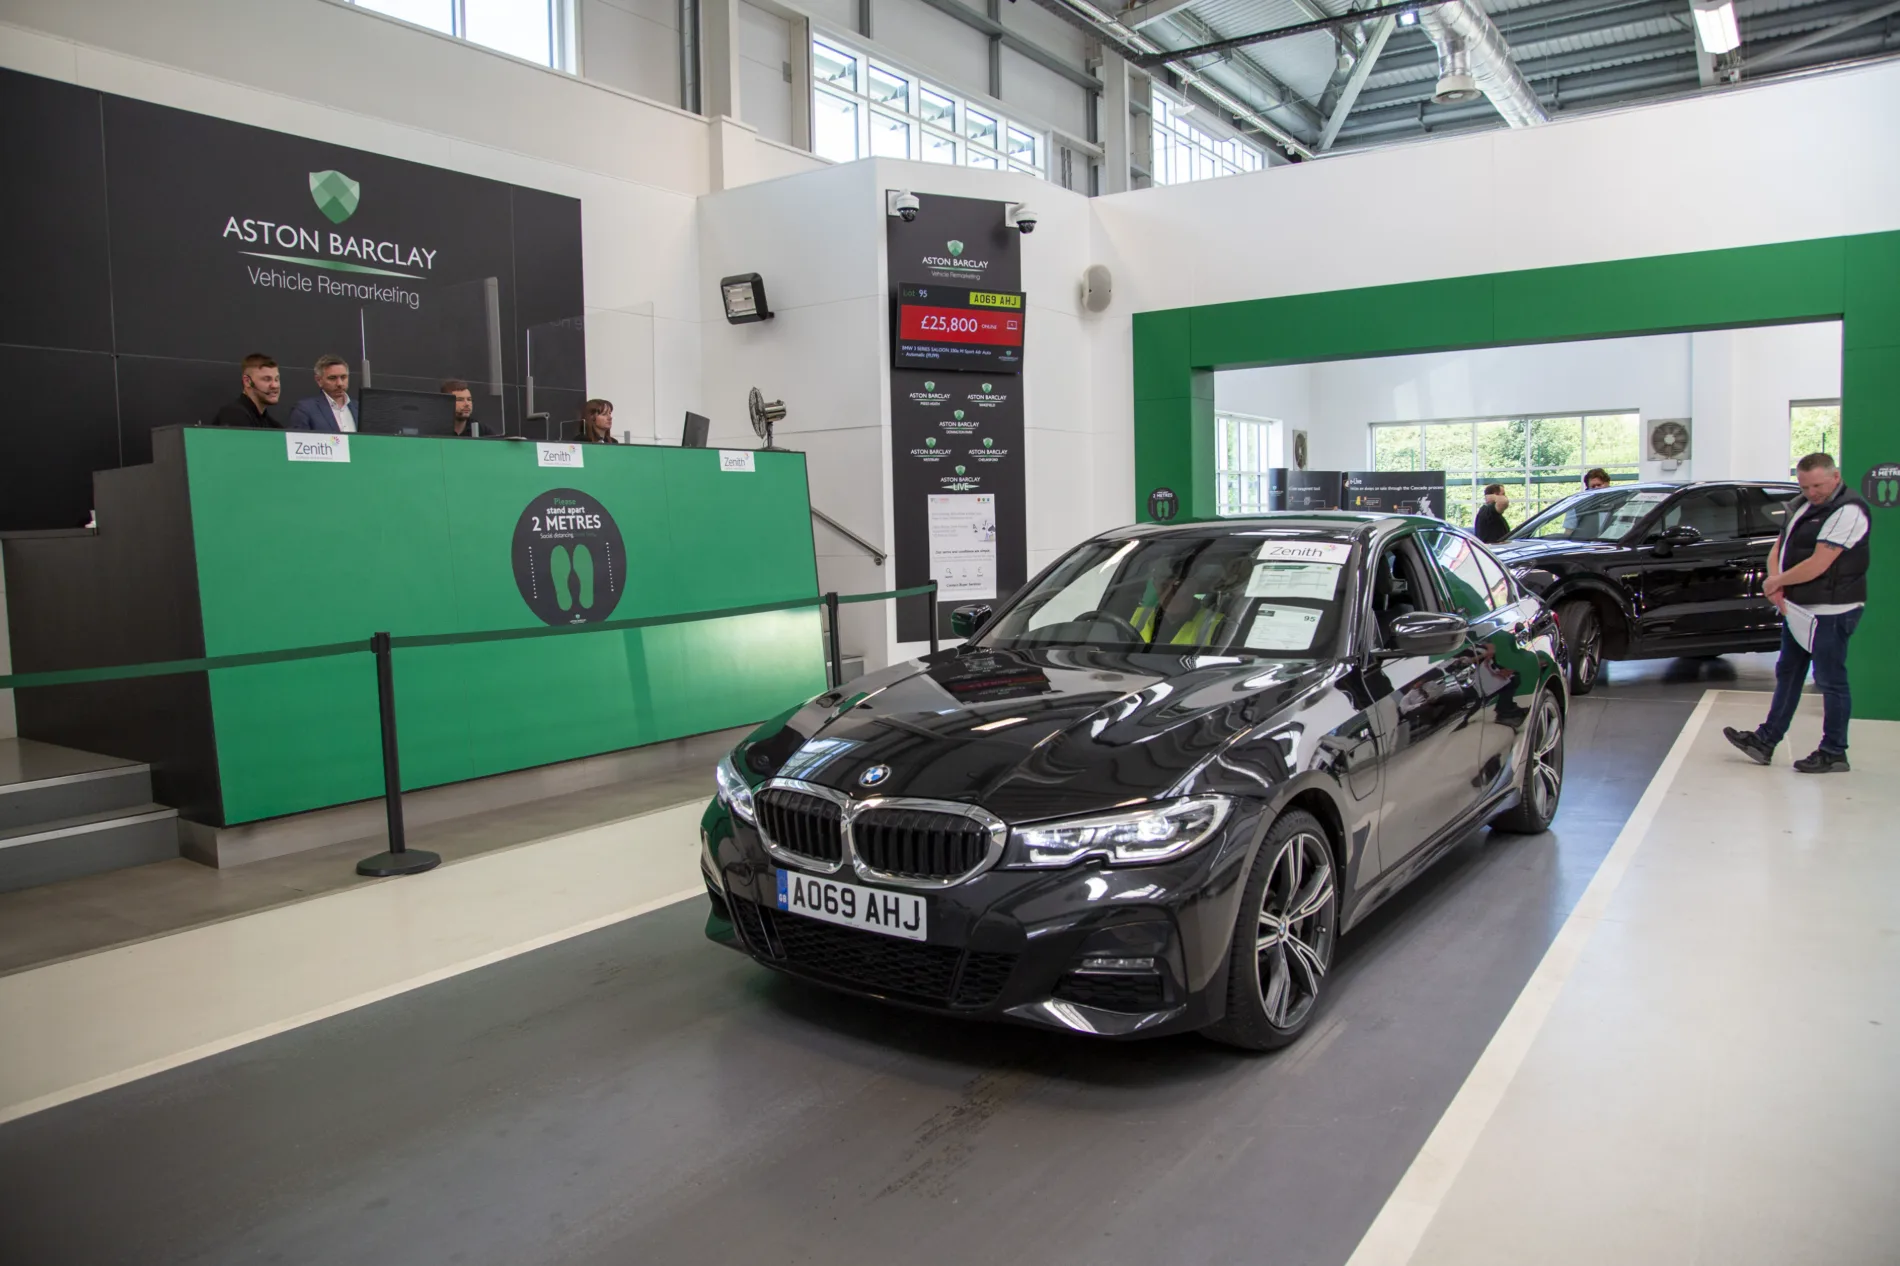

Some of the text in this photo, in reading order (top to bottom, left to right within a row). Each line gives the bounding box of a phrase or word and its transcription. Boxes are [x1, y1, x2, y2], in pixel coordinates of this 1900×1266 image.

[222, 216, 437, 270] ASTON BARCLAY
[922, 256, 988, 268] ASTON BARCLAY
[931, 270, 980, 281] Vehicle Remarketing
[247, 266, 420, 310] Vehicle Remarketing
[918, 290, 928, 298] 95
[1000, 296, 1016, 306] AHJ
[921, 315, 978, 333] £25,800
[295, 442, 333, 455] Zenith
[543, 450, 571, 461] Zenith
[724, 457, 745, 467] Zenith
[953, 483, 969, 491] LIVE
[554, 498, 576, 506] Please
[568, 506, 585, 515] apart
[532, 515, 602, 532] 2 METRES
[1269, 546, 1323, 558] Zenith
[778, 894, 787, 903] GB
[865, 892, 920, 932] AHJ
